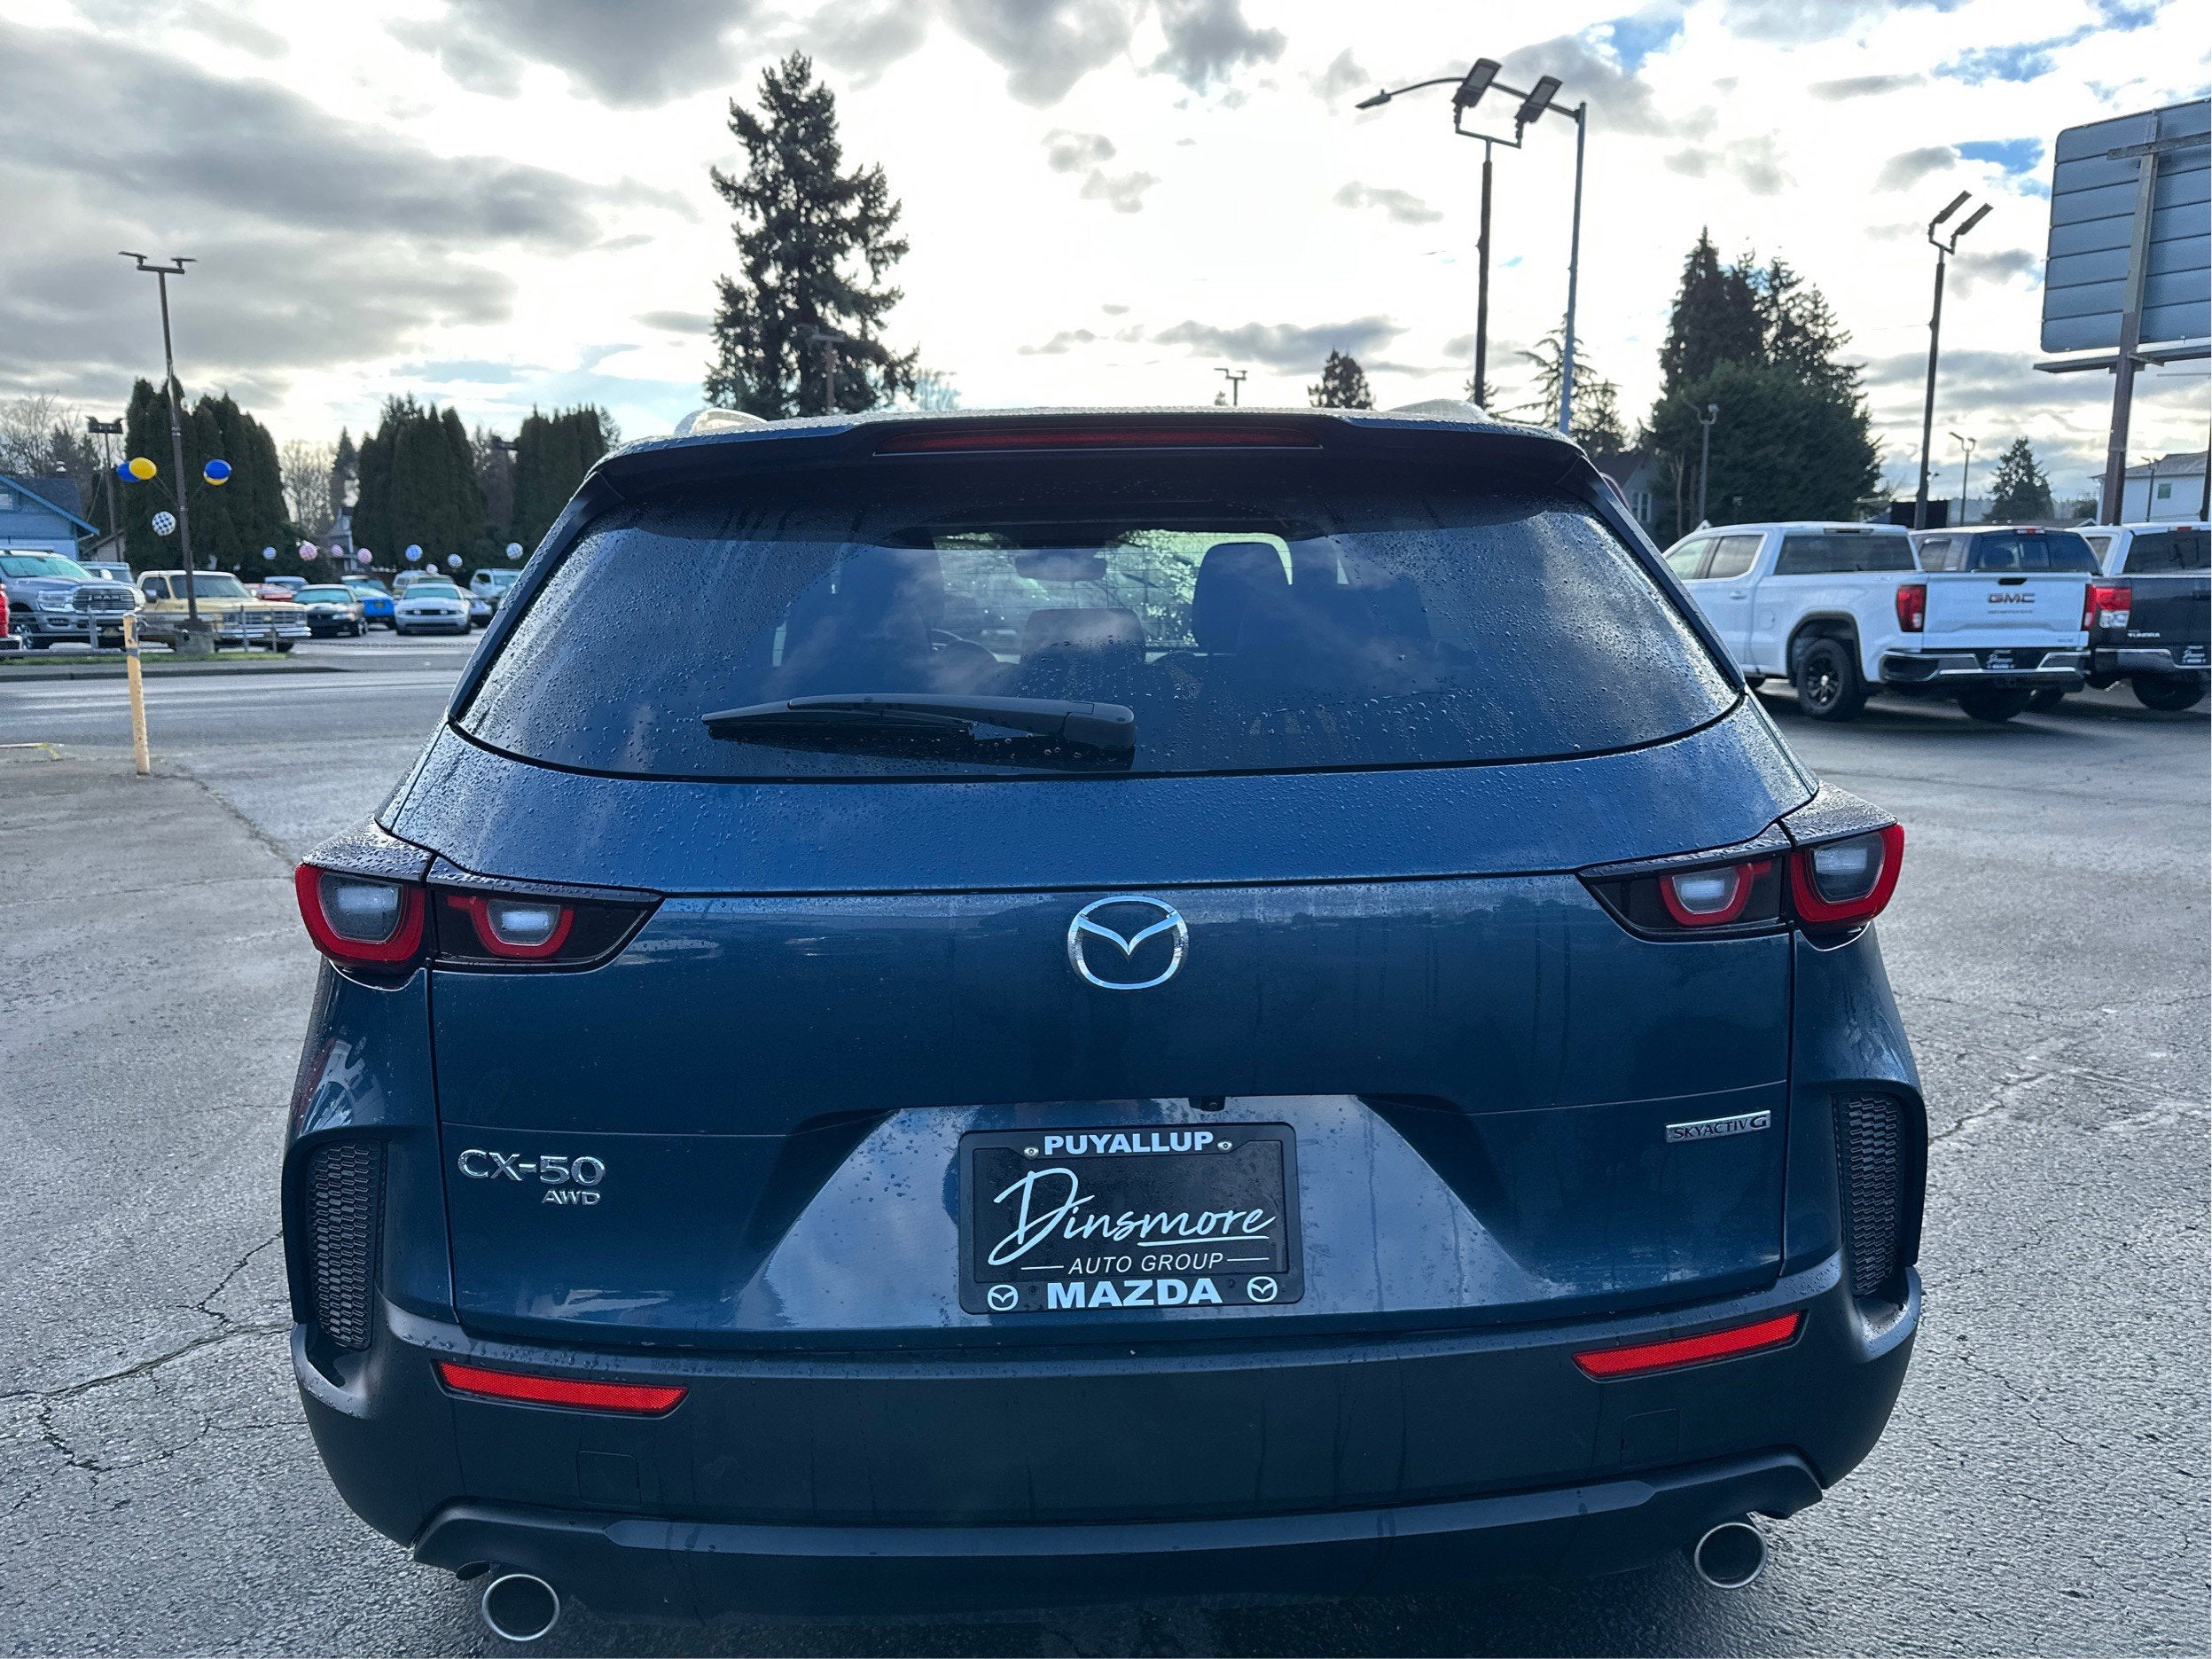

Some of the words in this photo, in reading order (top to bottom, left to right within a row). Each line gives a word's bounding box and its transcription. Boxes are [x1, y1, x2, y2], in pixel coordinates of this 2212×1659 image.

[1988, 592, 2036, 603] GMC
[1043, 1131, 1214, 1155] PUYALLUP
[457, 1148, 606, 1186] CX-50
[541, 1190, 601, 1206] AWD
[988, 1168, 1277, 1265] Dinsmore
[1067, 1256, 1132, 1275] AUTO
[1141, 1252, 1224, 1271] GROUP
[1047, 1278, 1223, 1309] MAZDA
